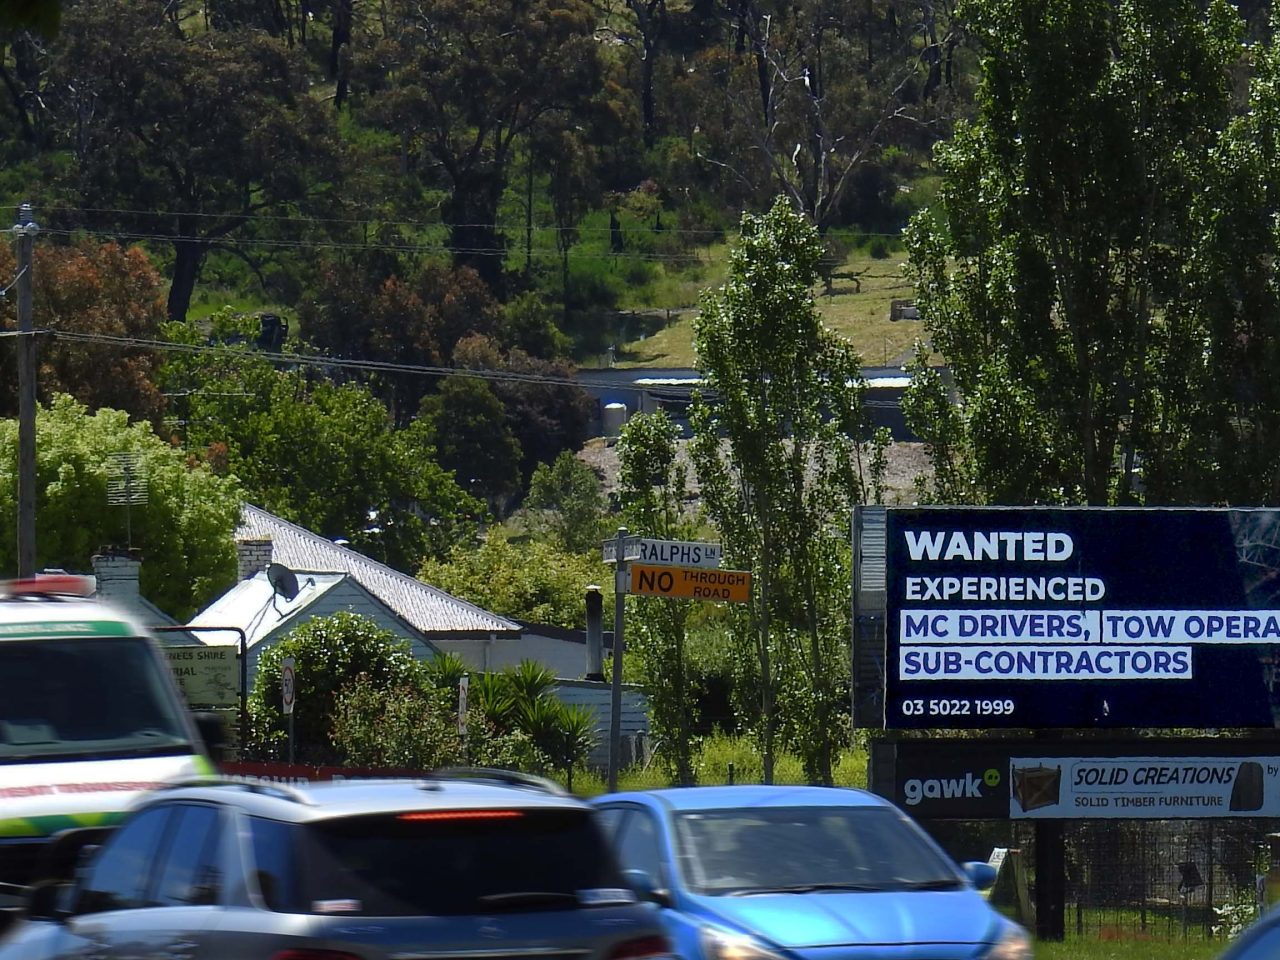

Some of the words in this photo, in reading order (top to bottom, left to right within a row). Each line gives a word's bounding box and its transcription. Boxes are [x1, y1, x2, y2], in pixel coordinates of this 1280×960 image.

[640, 543, 700, 563] RALPHS
[705, 547, 716, 559] LN
[904, 531, 1074, 561] WANTED
[638, 570, 674, 592] NO
[682, 570, 746, 586] THROUGH
[693, 587, 731, 599] ROAD
[905, 577, 1106, 601] EXPERIENCED
[905, 614, 949, 637] MC
[958, 614, 1091, 641] DRIVERS,
[1107, 616, 1175, 638] TOW
[904, 651, 1189, 675] SUB-CONTRACTORS
[902, 699, 924, 716] 03
[929, 699, 971, 716] 5022
[975, 699, 1015, 716] 1999
[1074, 767, 1129, 786] SOLID
[1132, 766, 1235, 786] CREATIONS
[1267, 764, 1279, 777] by
[904, 772, 983, 806] gawk
[1075, 796, 1108, 807] SOLID
[1113, 796, 1156, 807] TIMBER
[1158, 795, 1223, 807] FURNITURE
